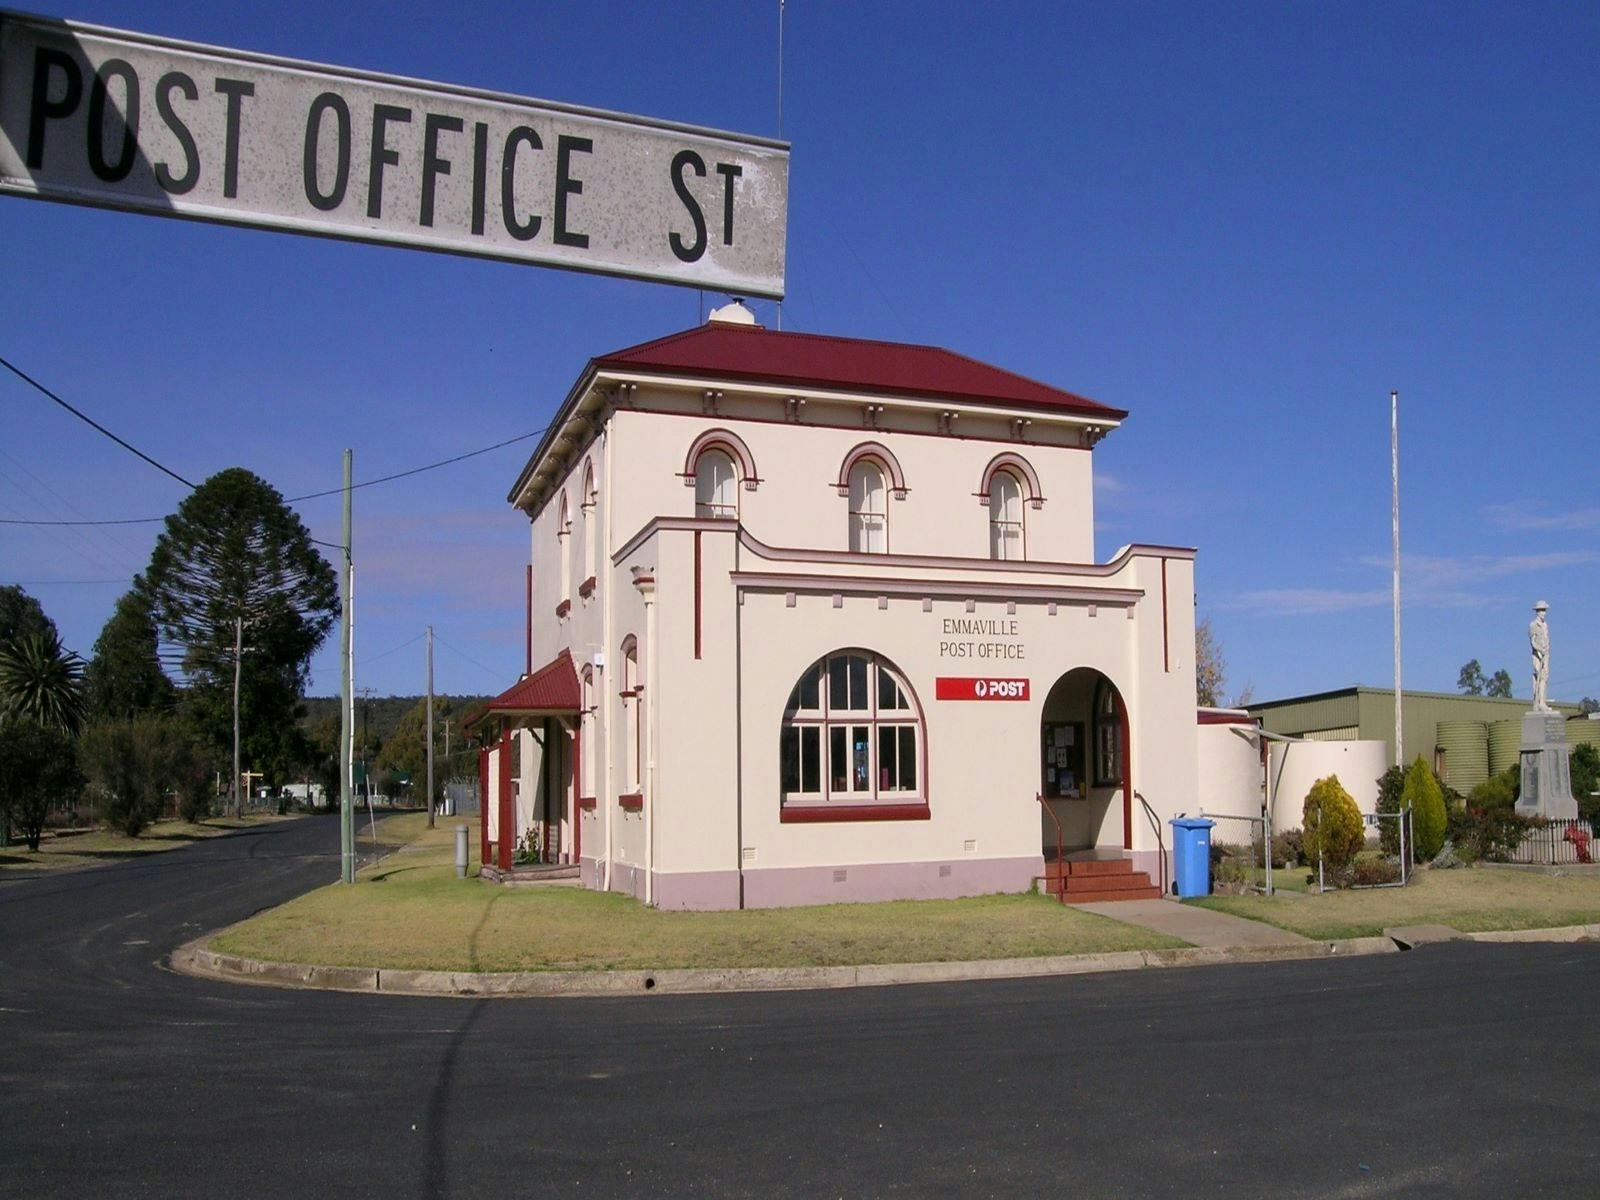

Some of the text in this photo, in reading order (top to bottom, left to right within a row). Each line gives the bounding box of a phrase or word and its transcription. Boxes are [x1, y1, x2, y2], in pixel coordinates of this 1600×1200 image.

[26, 46, 744, 264] POST OFFICE ST
[943, 619, 1018, 635] EMMAVILLE
[940, 641, 1024, 658] POST OFFICE
[989, 681, 1025, 696] POST
